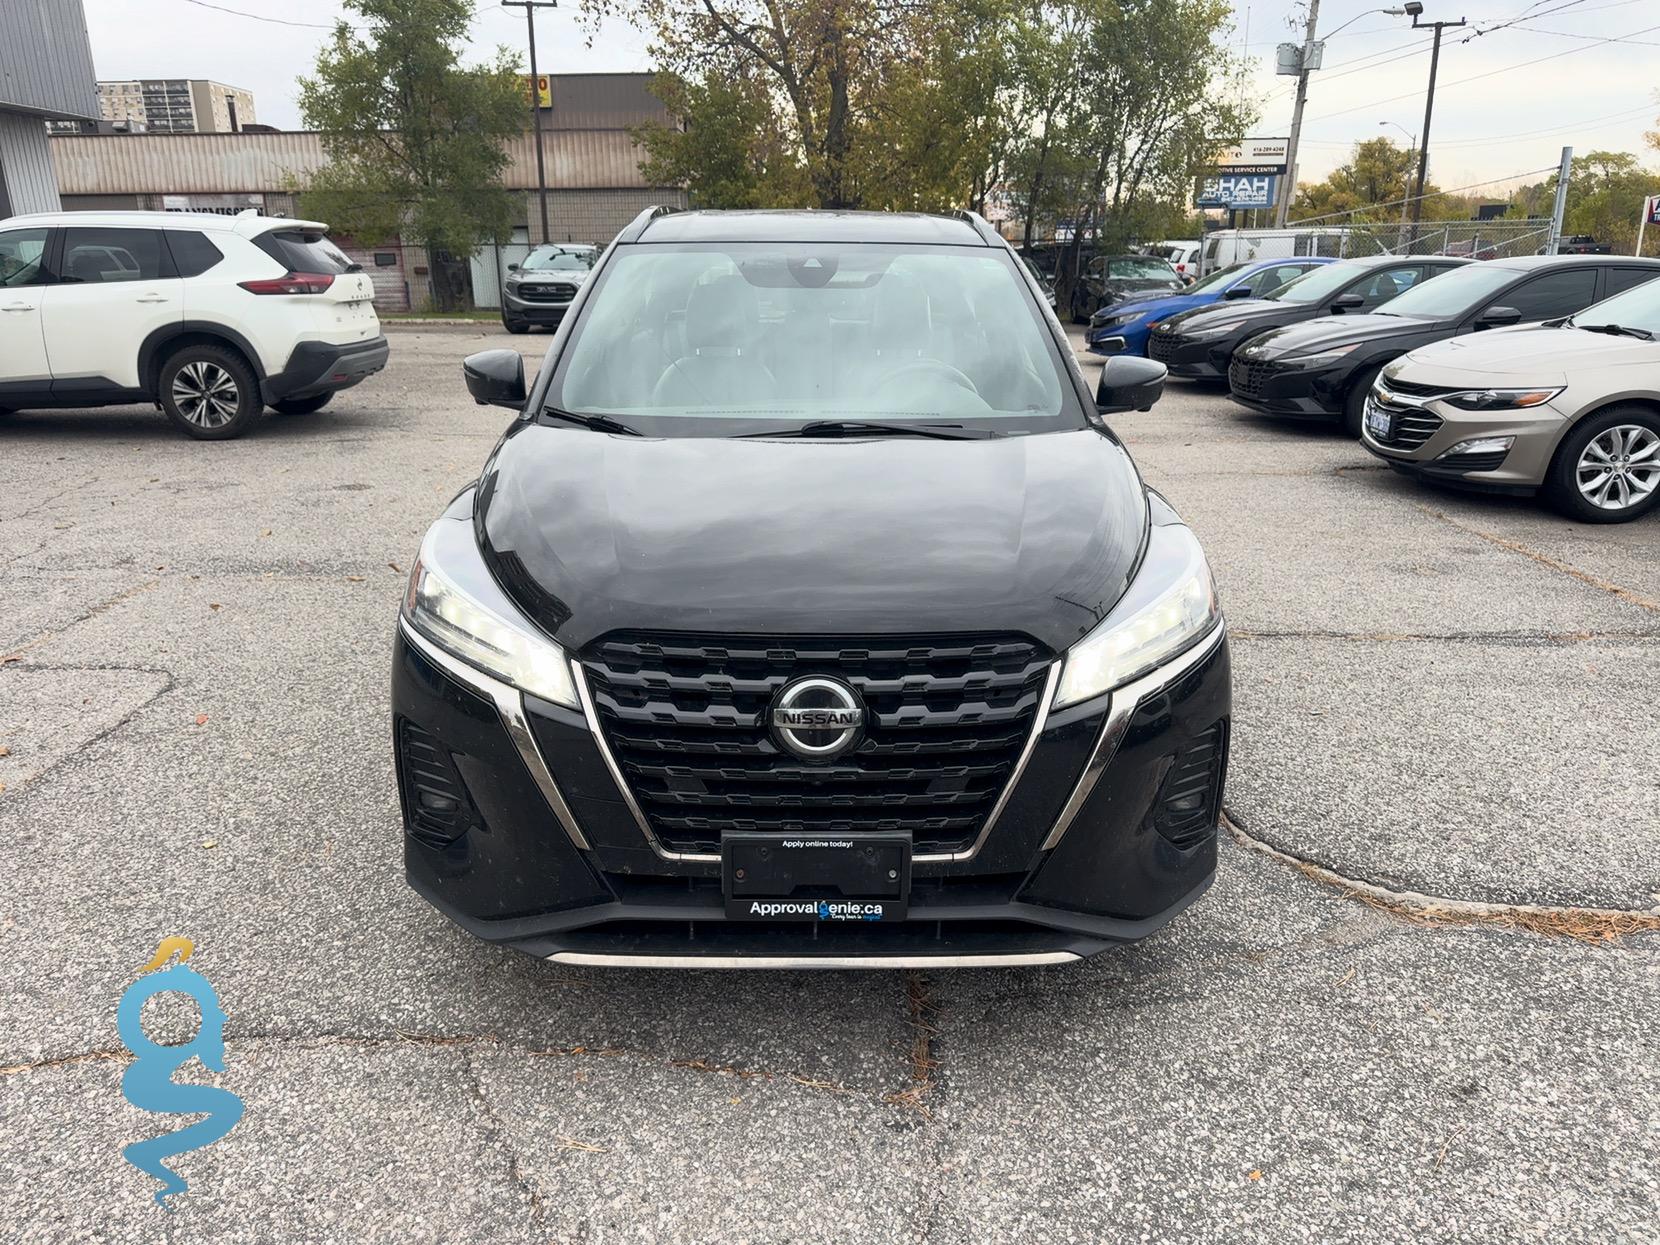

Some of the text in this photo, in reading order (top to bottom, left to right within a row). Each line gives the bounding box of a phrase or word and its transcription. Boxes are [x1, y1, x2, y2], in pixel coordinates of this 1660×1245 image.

[1203, 177, 1269, 192] SHAH
[1202, 190, 1268, 198] AUTO REPAIR
[166, 208, 264, 216] NSMISSIN
[782, 712, 853, 725] NISSAN
[782, 840, 804, 848] Apply
[829, 840, 853, 849] today!
